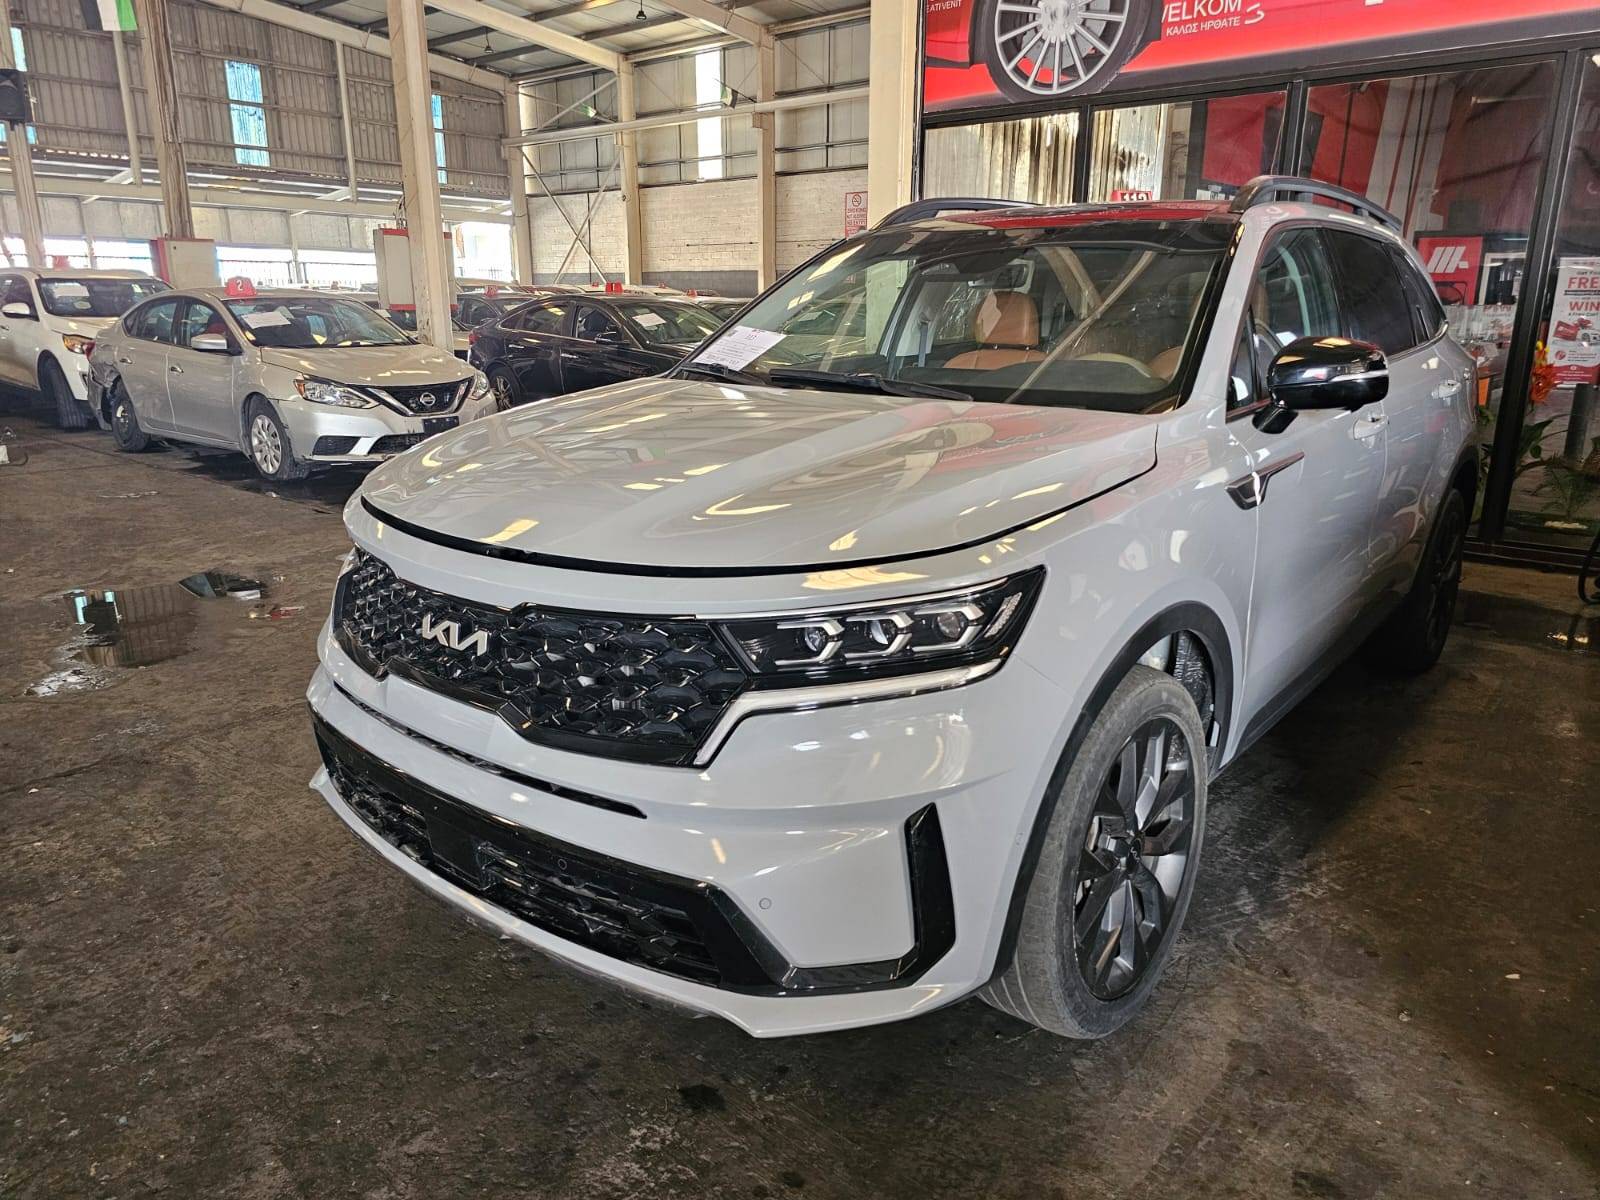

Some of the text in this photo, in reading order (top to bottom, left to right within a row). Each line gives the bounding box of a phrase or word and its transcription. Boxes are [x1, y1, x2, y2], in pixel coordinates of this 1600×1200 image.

[1161, 0, 1242, 23] ELKOM
[1166, 16, 1241, 36] ΚΑΛΩΣ ΗΡΘΑΤΕ
[1569, 301, 1600, 312] WIN
[422, 614, 488, 657] KIA
